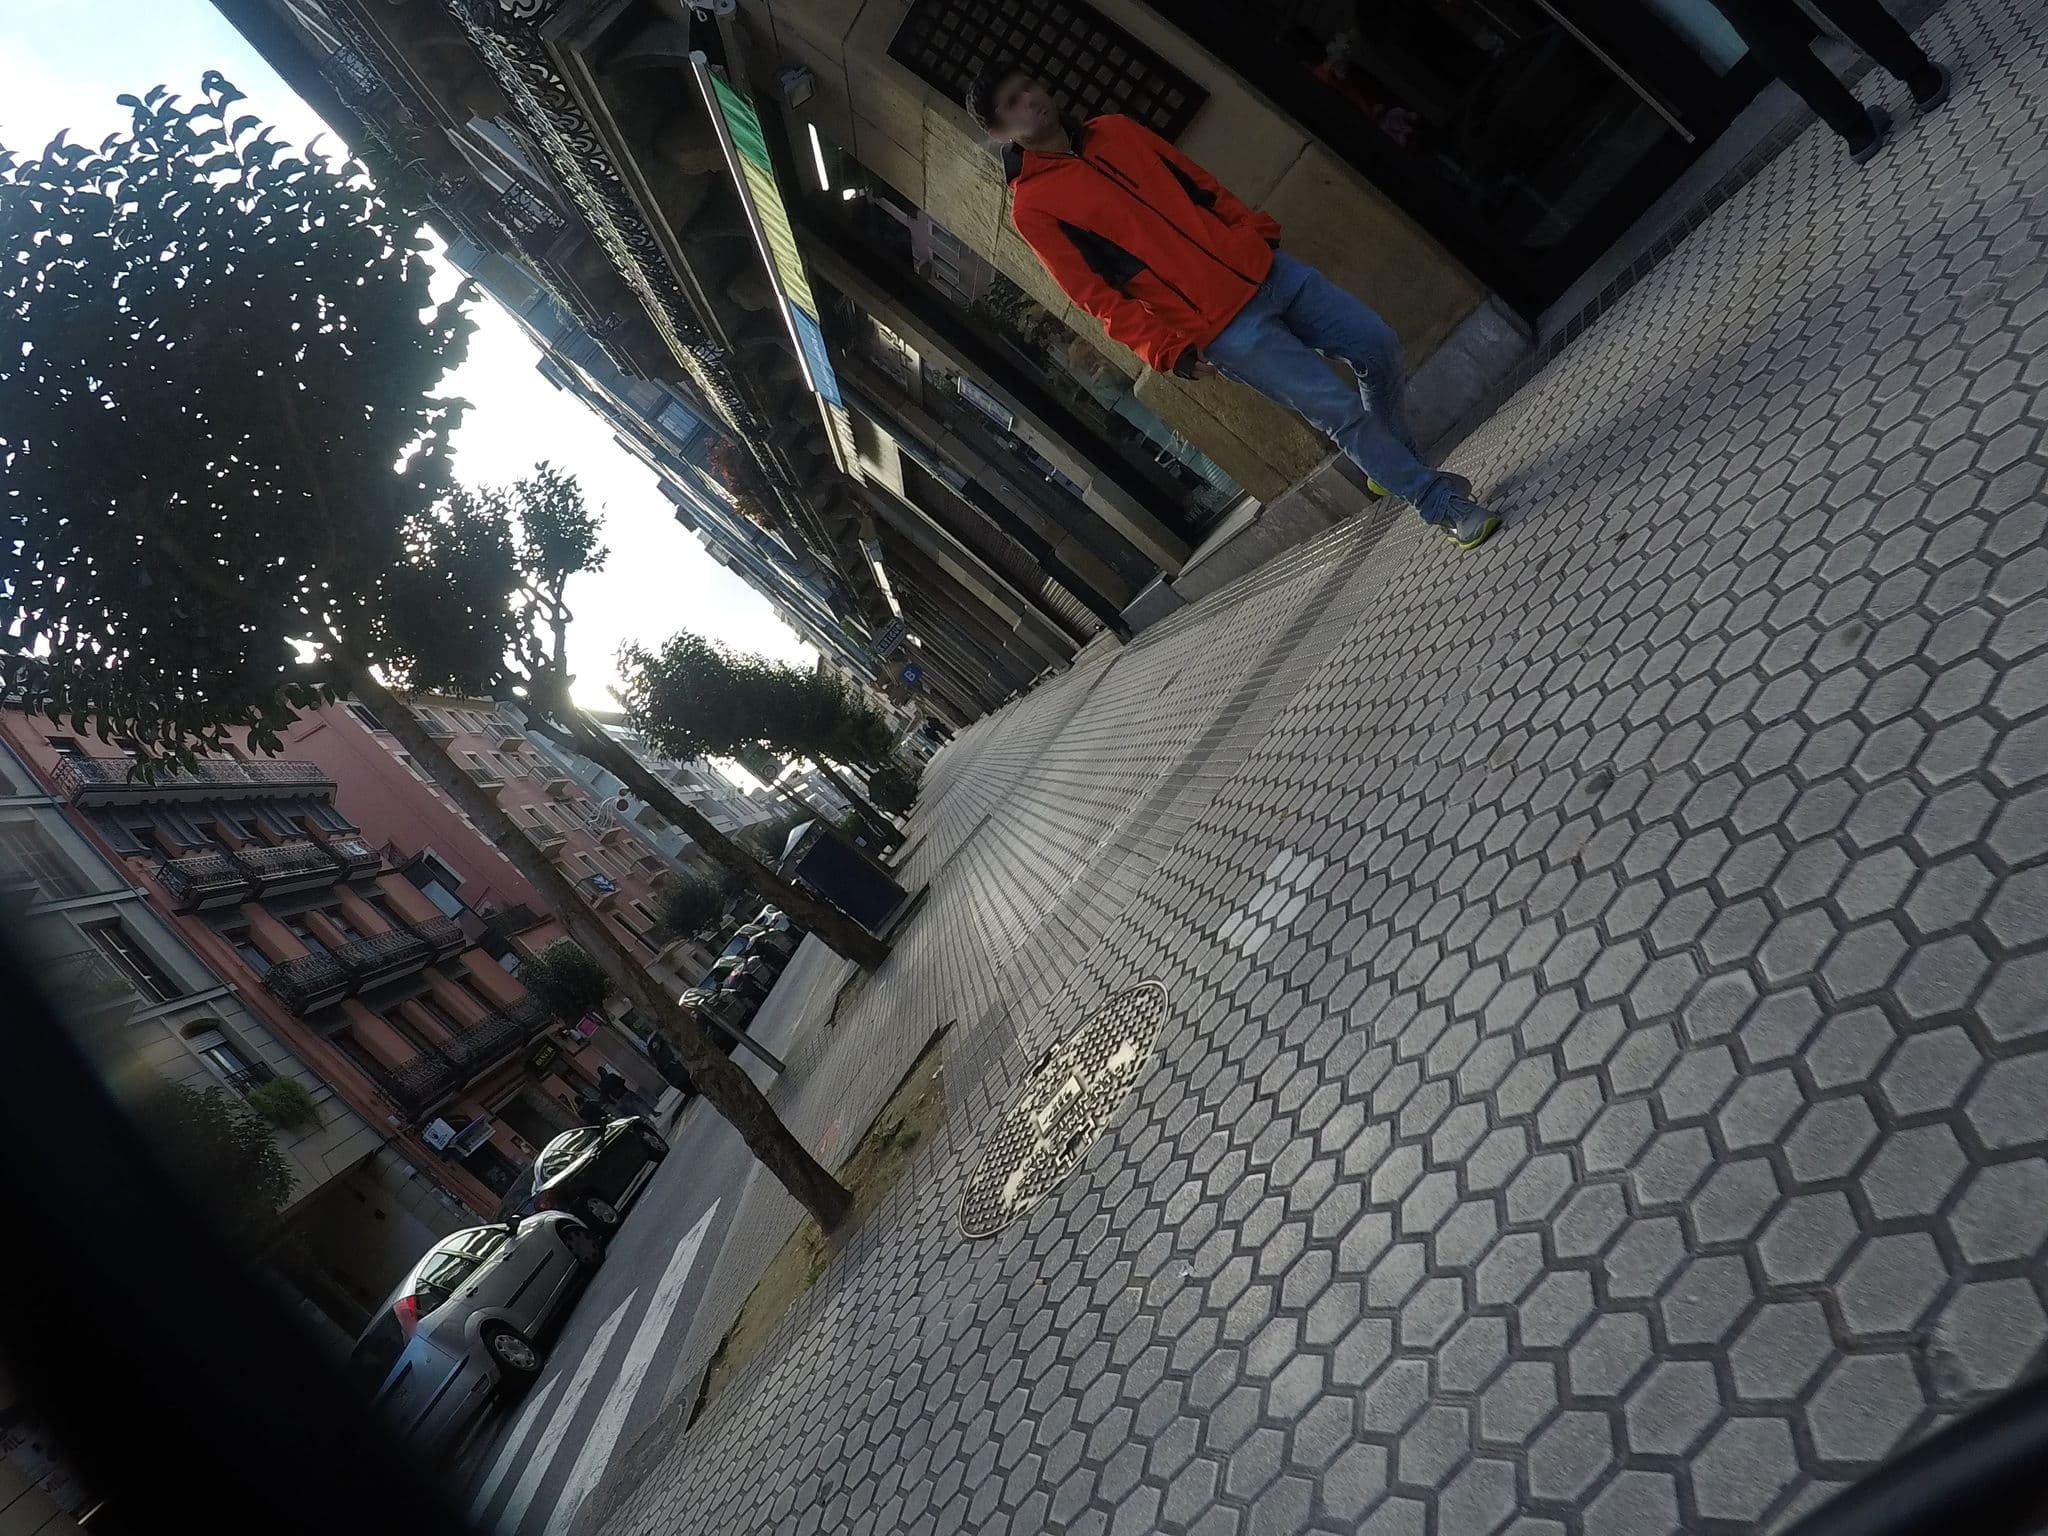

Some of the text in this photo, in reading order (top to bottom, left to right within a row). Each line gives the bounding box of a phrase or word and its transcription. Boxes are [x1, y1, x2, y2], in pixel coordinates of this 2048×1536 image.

[1016, 1065, 1123, 1188] SANEAMIENTO
[1022, 1069, 1111, 1170] UR ZIKINAK
